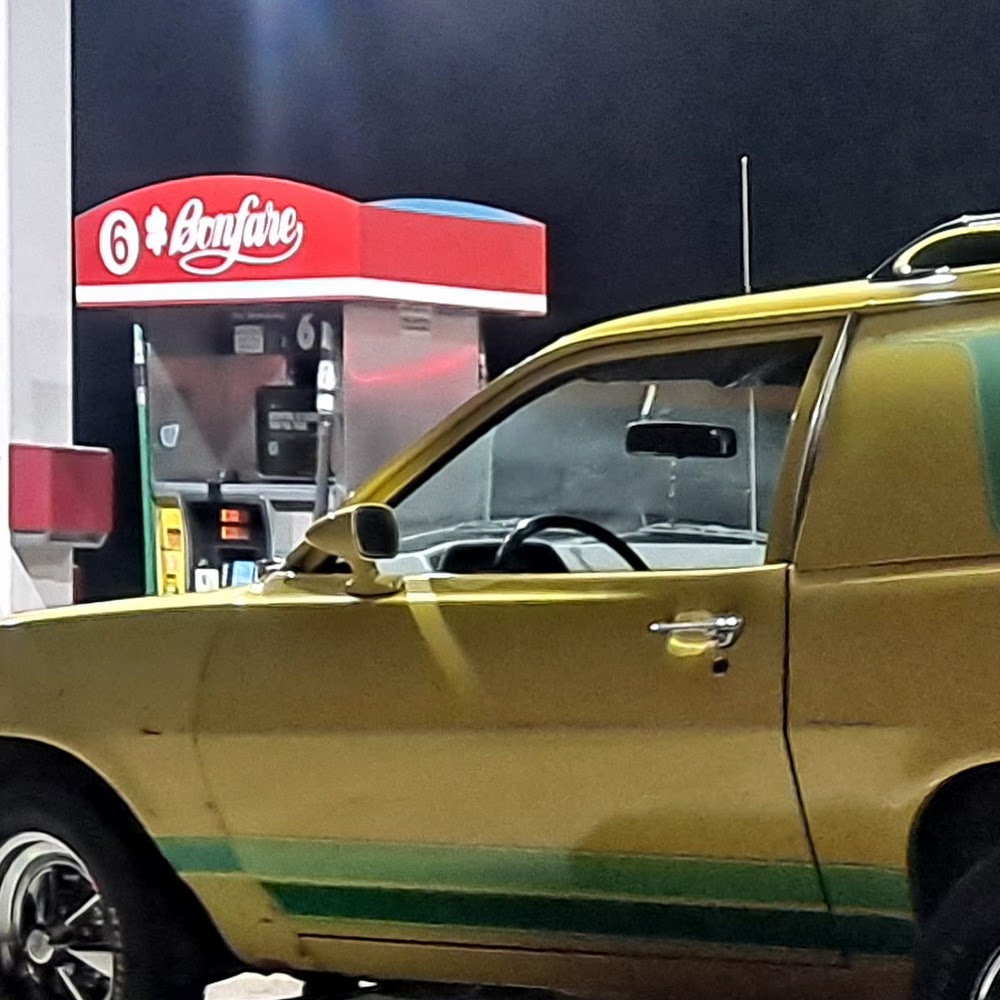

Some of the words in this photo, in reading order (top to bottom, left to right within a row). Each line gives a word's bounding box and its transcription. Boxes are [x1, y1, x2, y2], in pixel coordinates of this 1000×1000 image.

[110, 219, 129, 265] 6
[168, 195, 303, 275] Bonfare
[297, 313, 315, 350] 6
